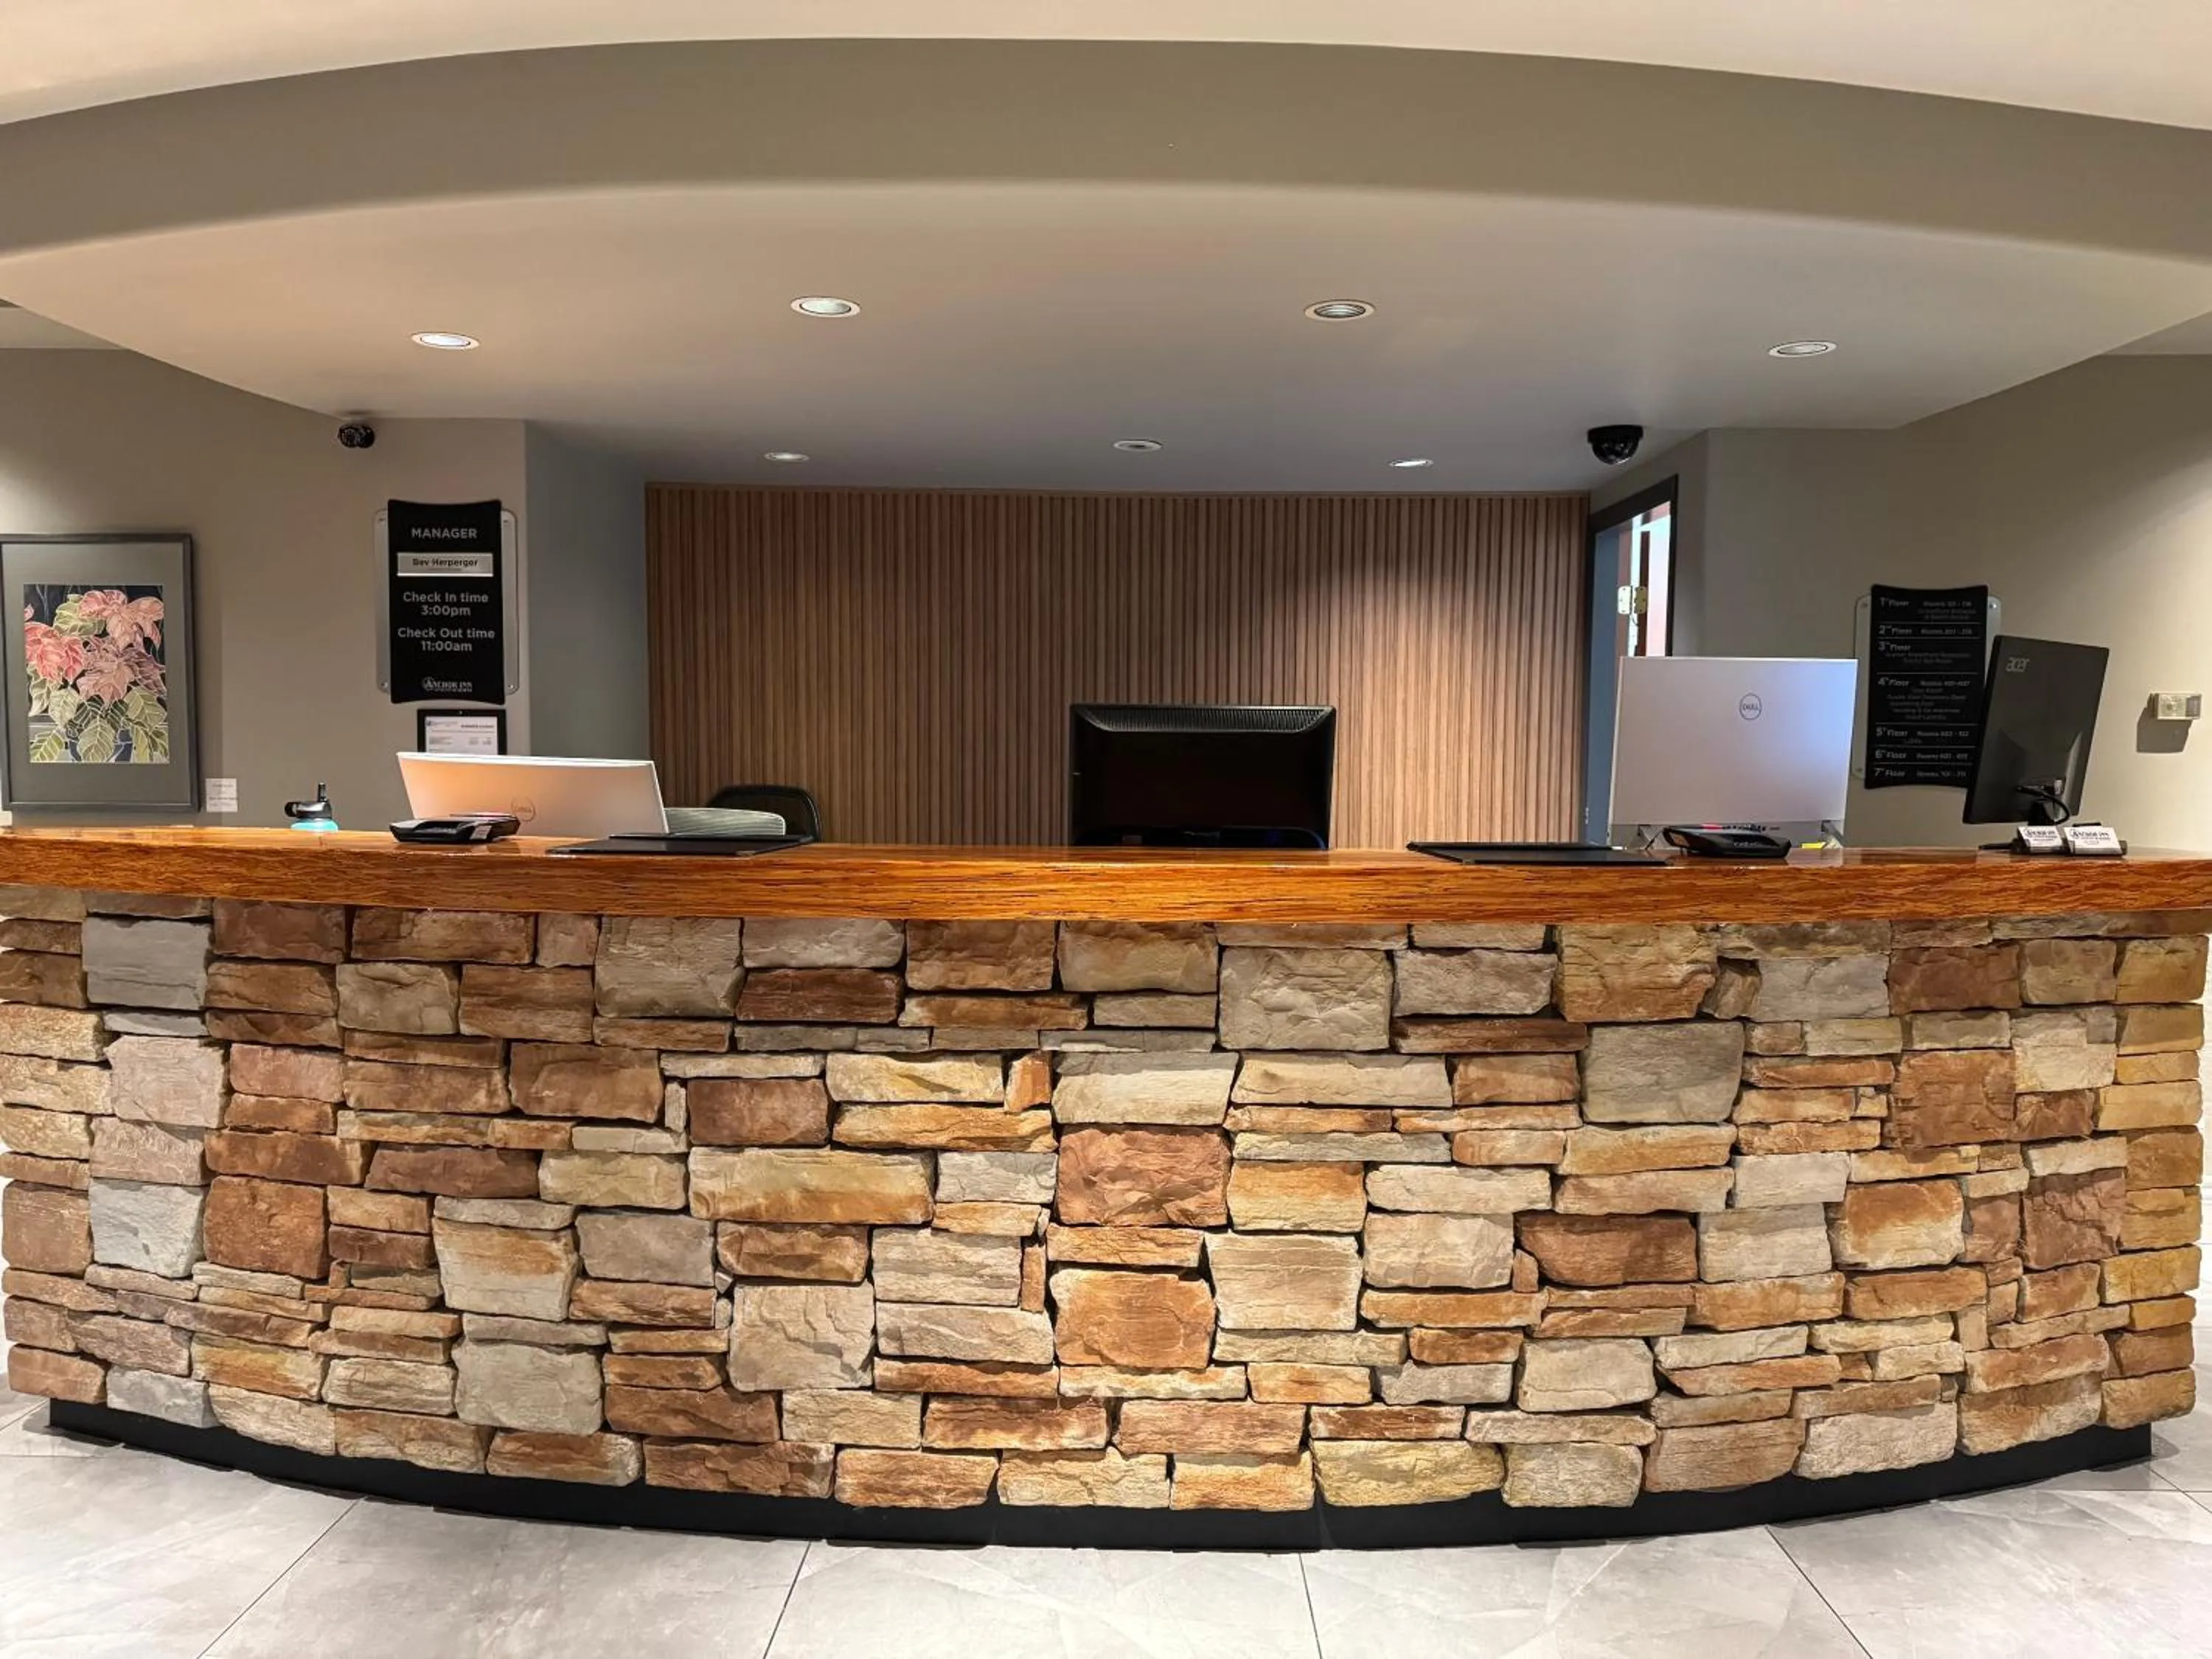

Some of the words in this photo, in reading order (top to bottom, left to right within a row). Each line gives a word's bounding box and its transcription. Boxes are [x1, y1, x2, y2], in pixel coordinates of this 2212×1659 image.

[411, 527, 478, 540] MANAGER
[412, 557, 428, 566] Bev
[403, 591, 442, 603] Check
[445, 592, 456, 602] In
[459, 591, 489, 603] time
[420, 605, 471, 617] 3:00pm
[397, 627, 437, 639] Check
[439, 628, 463, 639] Out
[466, 628, 495, 639] time
[421, 641, 473, 652] 11:00am
[2006, 657, 2031, 672] acer
[1742, 703, 1759, 711] DELL
